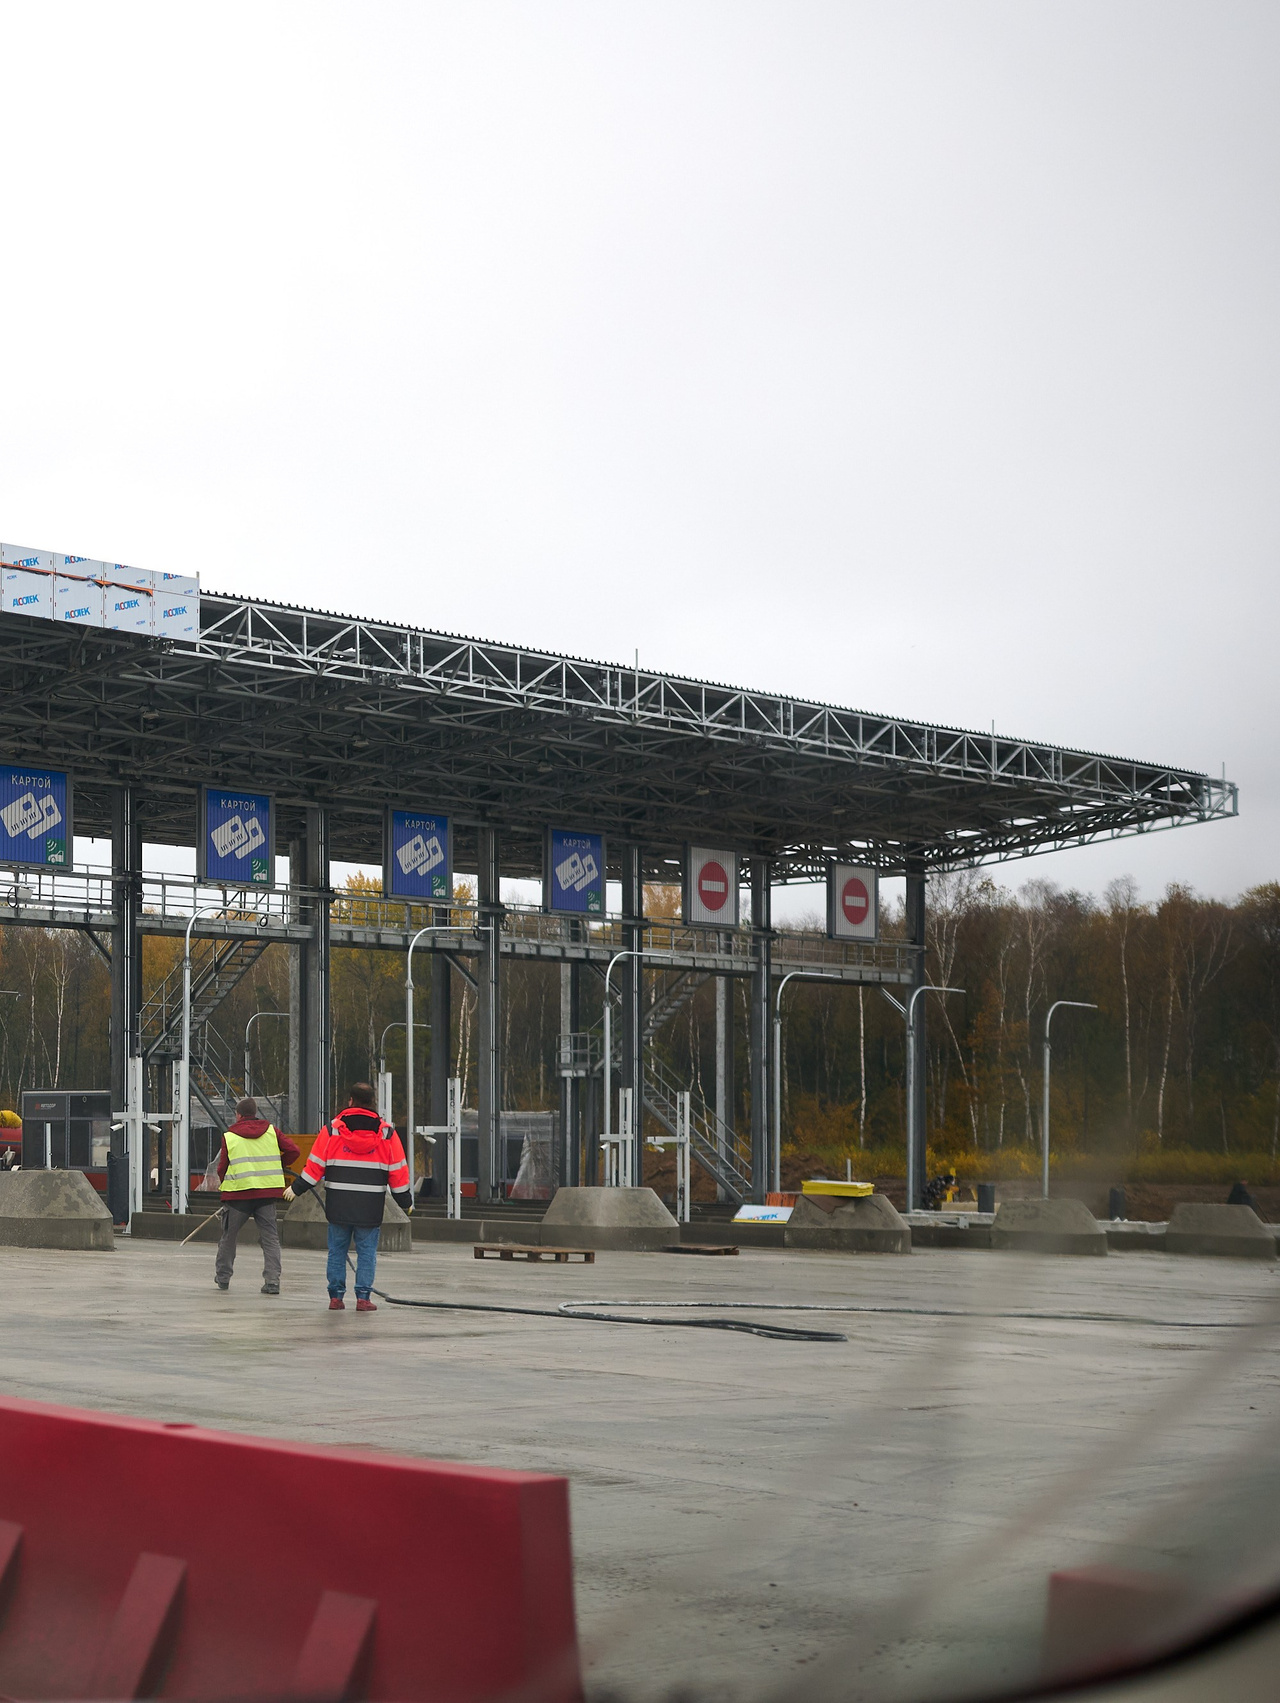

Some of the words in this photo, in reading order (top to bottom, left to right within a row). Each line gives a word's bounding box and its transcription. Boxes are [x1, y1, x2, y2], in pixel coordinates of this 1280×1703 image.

[12, 595, 39, 608] ALCOTEK
[114, 600, 139, 613] ALCOTEK
[64, 607, 90, 621] ALCOTEK
[163, 607, 188, 619] ALCOTEK
[11, 774, 51, 788] КАРТОЙ
[220, 799, 256, 811] КАРТОЙ
[405, 819, 436, 831] КАРТОЙ
[563, 838, 591, 849] КАРТОЙ
